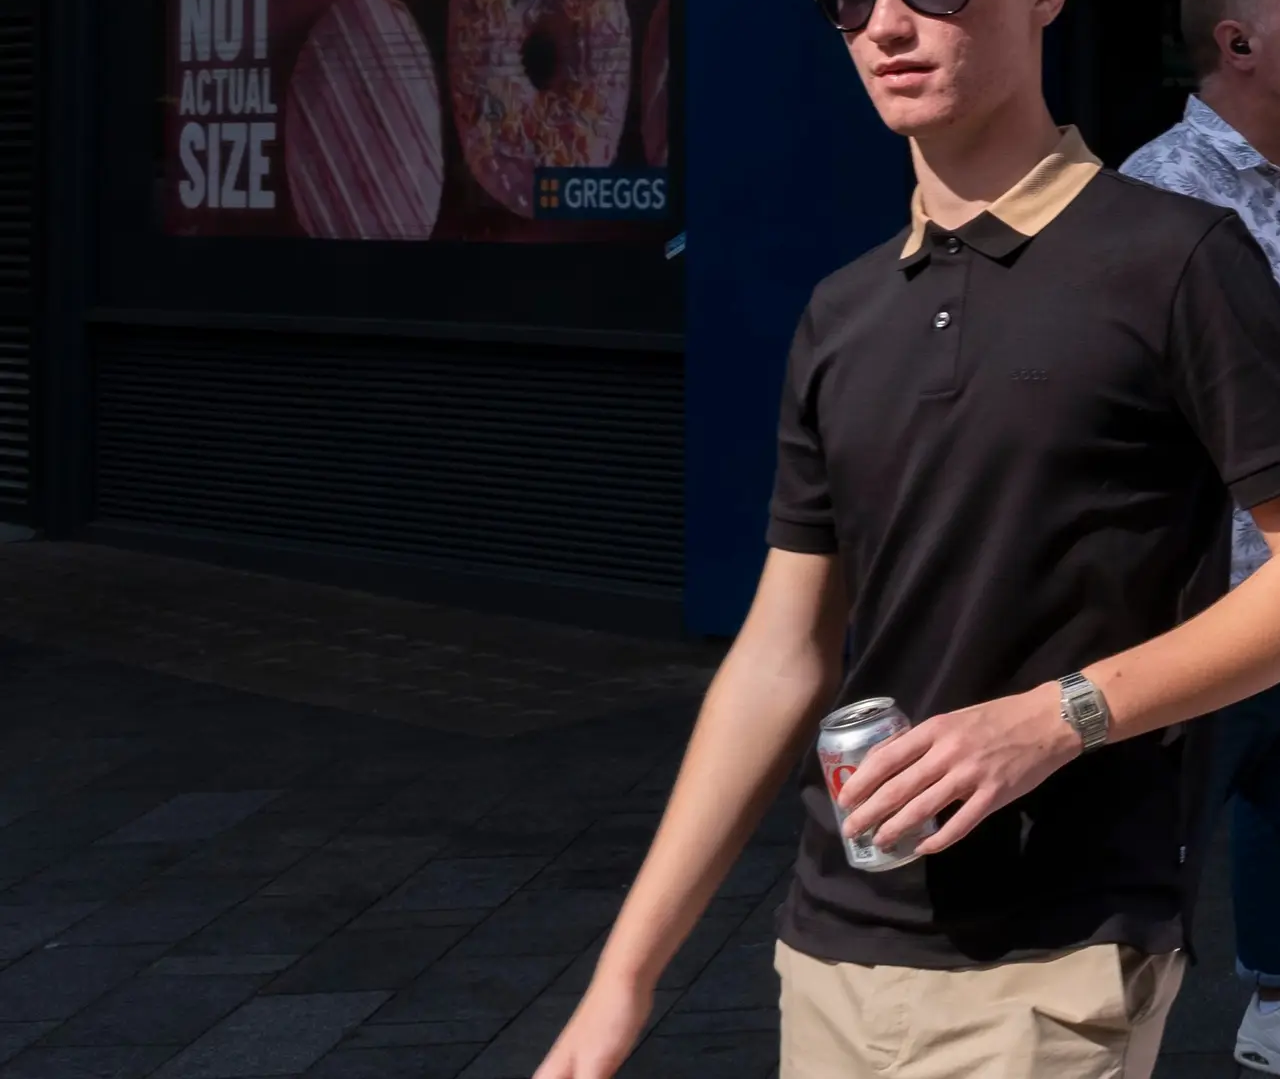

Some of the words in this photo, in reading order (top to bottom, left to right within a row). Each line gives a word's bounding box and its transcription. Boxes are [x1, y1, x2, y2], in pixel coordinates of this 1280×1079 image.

[179, 67, 278, 116] ACTUAL
[179, 122, 276, 209] SIZE
[564, 177, 666, 209] GREGGS
